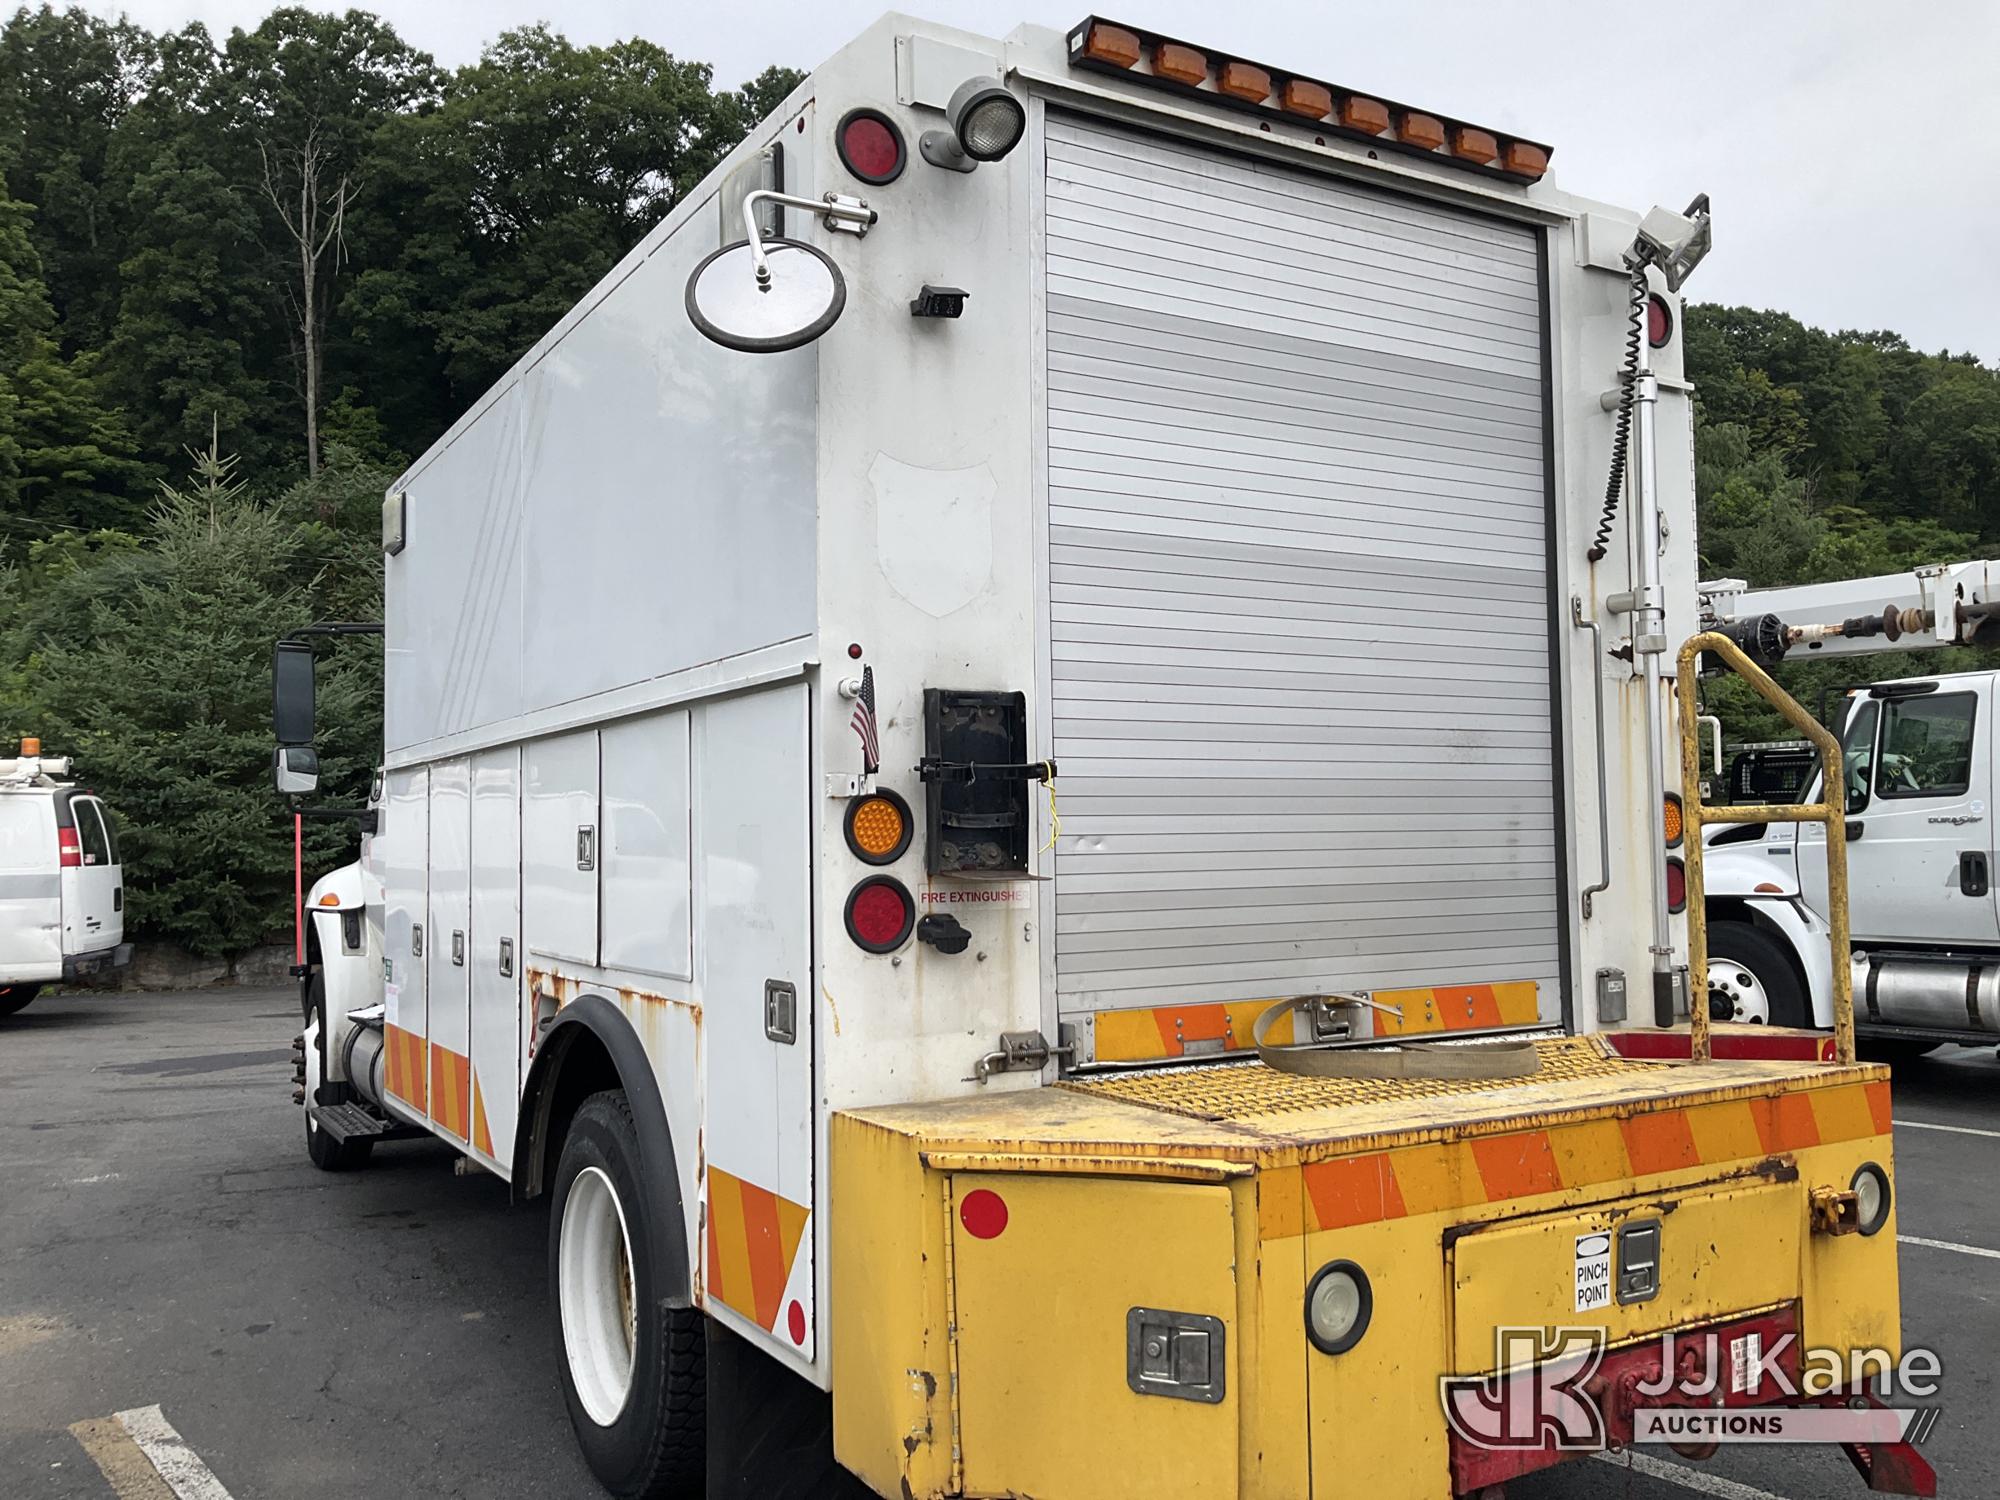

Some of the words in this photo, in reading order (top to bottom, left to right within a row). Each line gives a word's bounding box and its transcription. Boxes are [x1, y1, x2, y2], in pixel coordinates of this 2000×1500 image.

[921, 892, 946, 903] FIRE
[1577, 1261, 1608, 1283] PINCH
[1578, 1283, 1608, 1305] POINT
